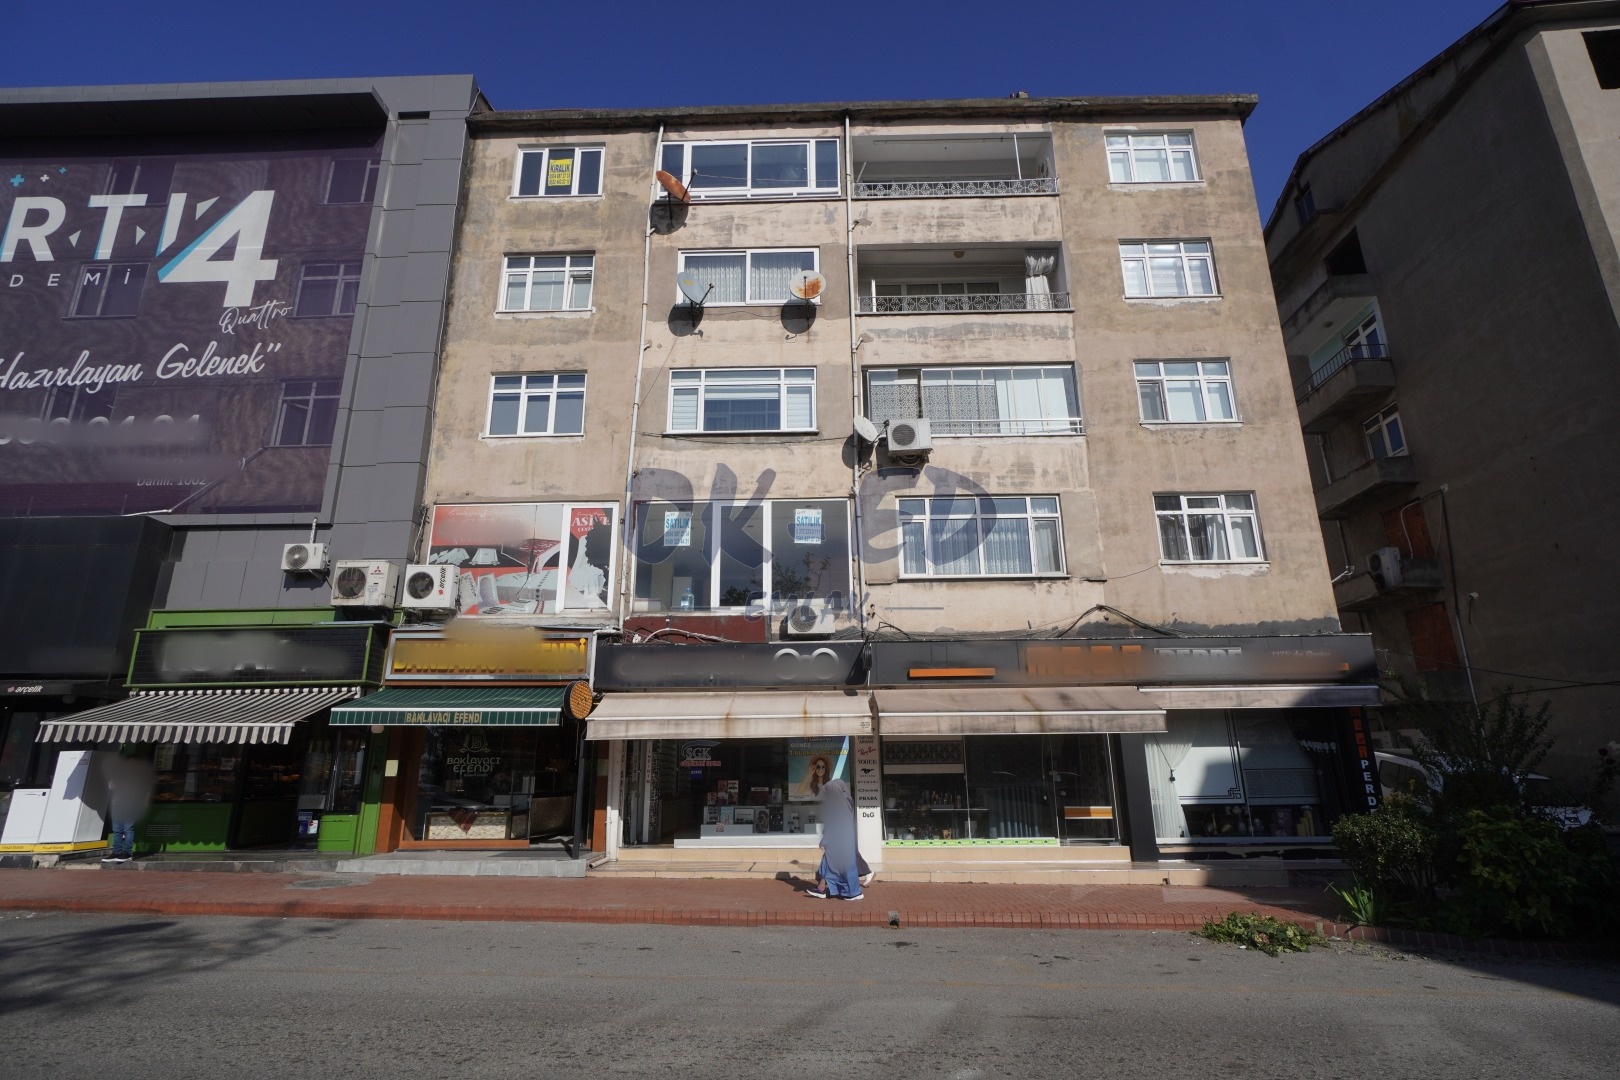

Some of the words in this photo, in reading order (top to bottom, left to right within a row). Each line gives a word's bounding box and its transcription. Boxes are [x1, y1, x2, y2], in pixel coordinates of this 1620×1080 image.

[219, 300, 294, 334] Quattro
[665, 518, 690, 529] SATILIK
[796, 516, 821, 527] SATILIK
[15, 685, 44, 695] arçelik
[406, 712, 451, 723] BAKLAVACI
[685, 747, 712, 759] SGK
[1361, 760, 1378, 815] PERD
